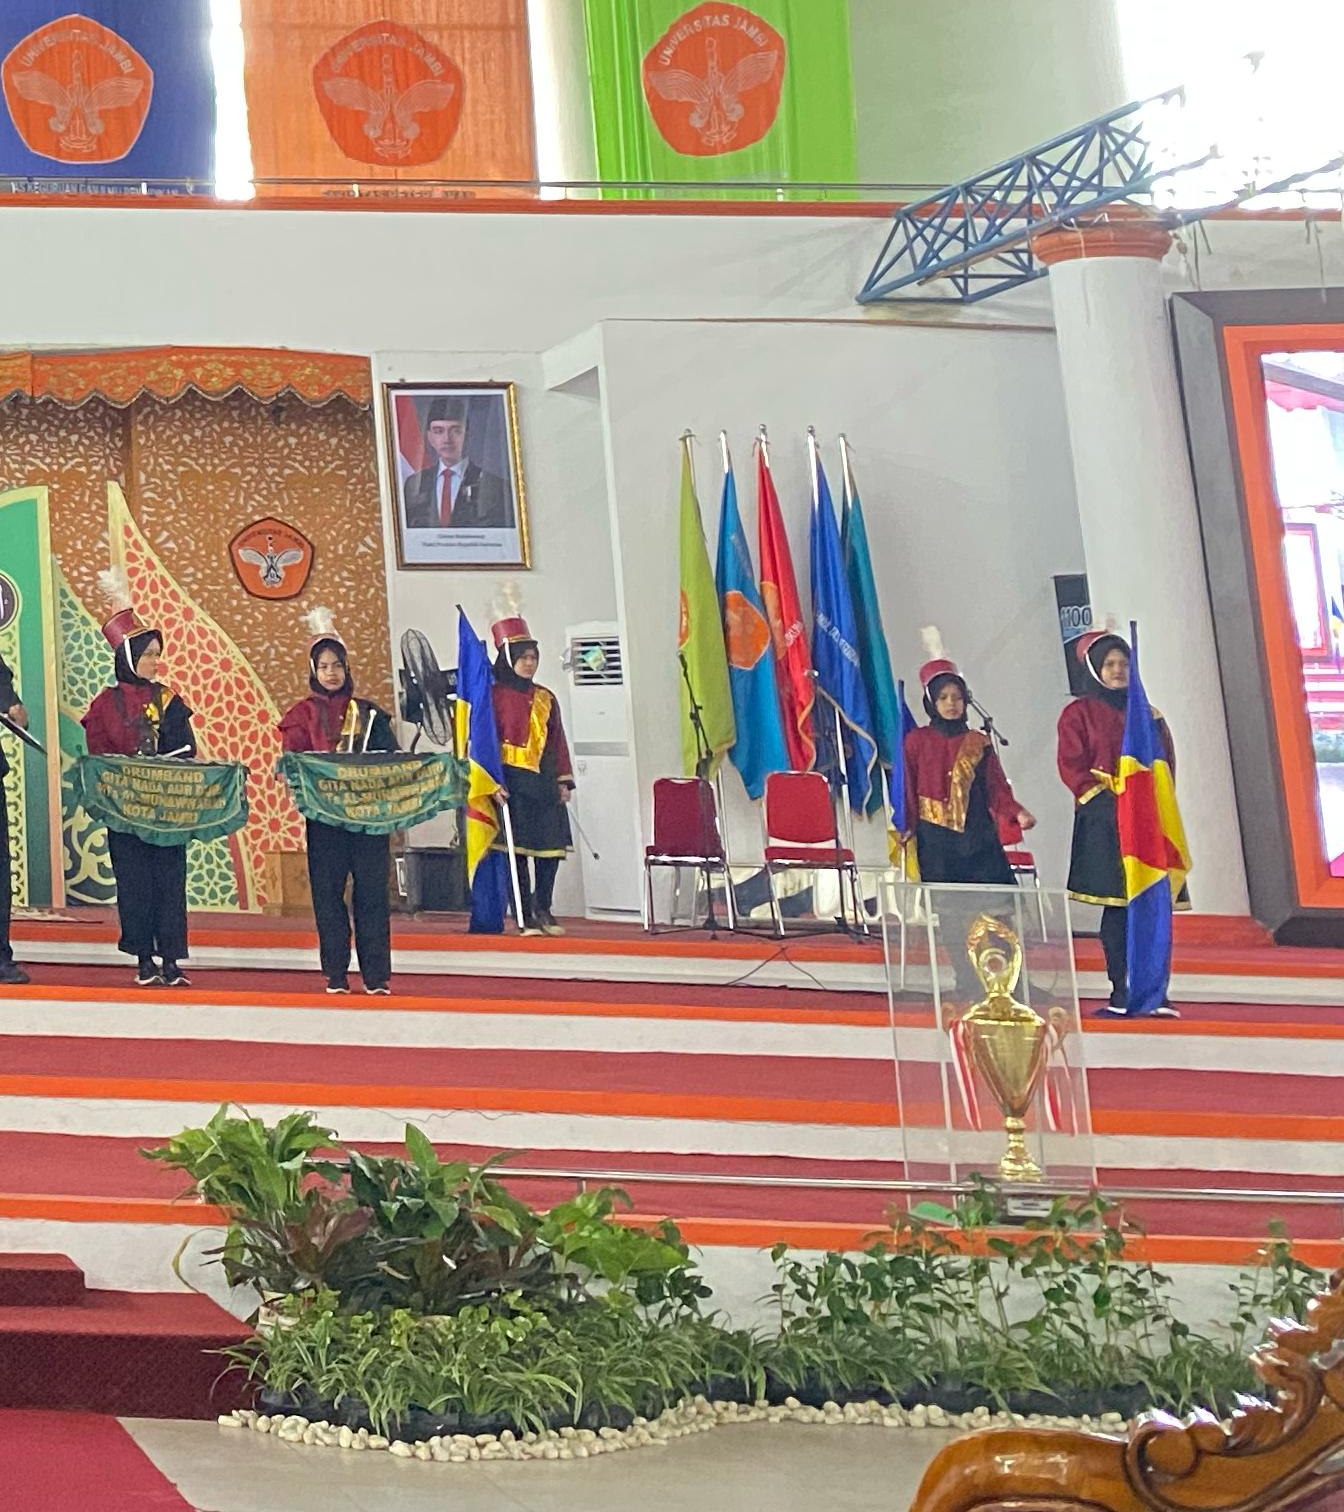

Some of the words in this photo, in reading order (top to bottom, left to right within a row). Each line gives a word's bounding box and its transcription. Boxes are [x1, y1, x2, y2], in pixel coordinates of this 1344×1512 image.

[659, 14, 730, 66] UNIVERSITAS
[122, 765, 205, 784] DRUMBAND
[122, 804, 156, 820] KOTA
[161, 808, 199, 824] JAMBI
